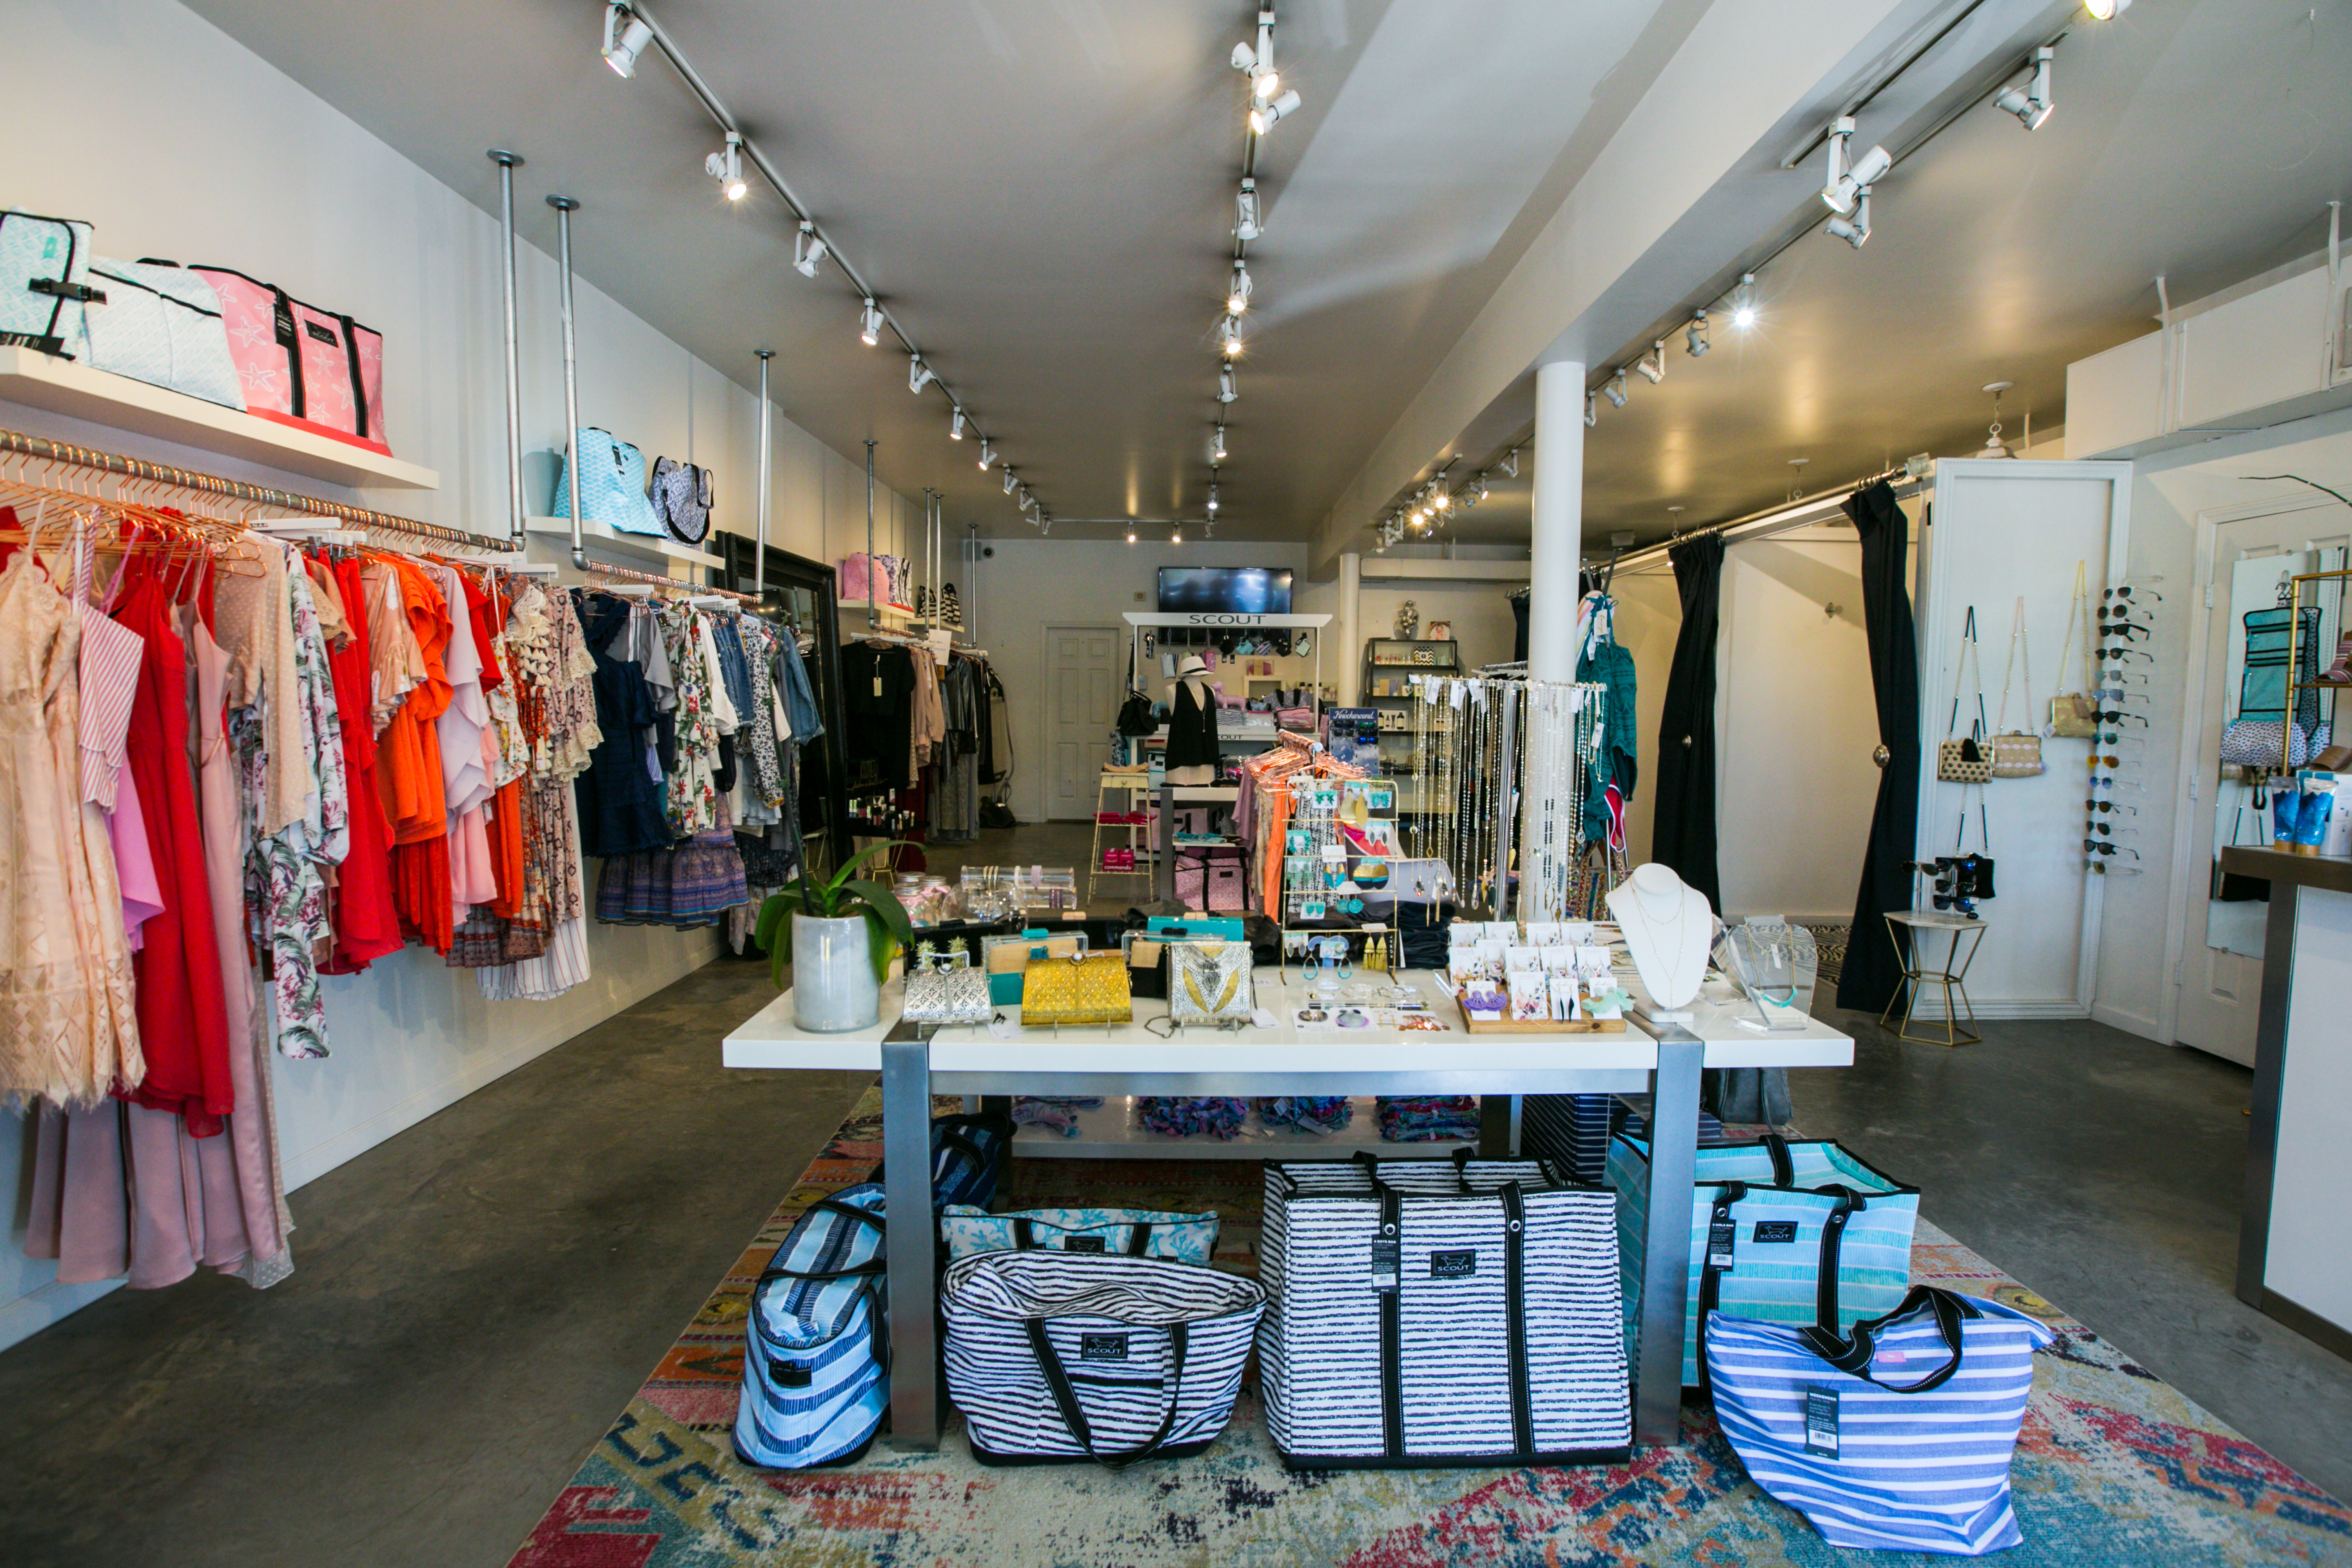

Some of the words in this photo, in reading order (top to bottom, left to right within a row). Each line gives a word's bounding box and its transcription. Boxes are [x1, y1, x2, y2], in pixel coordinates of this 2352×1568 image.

[312, 332, 334, 343] SCOUT
[1189, 615, 1266, 624] SCOUT
[1333, 709, 1374, 719] Knockaround
[1809, 1392, 1837, 1401] WEEKENDER
